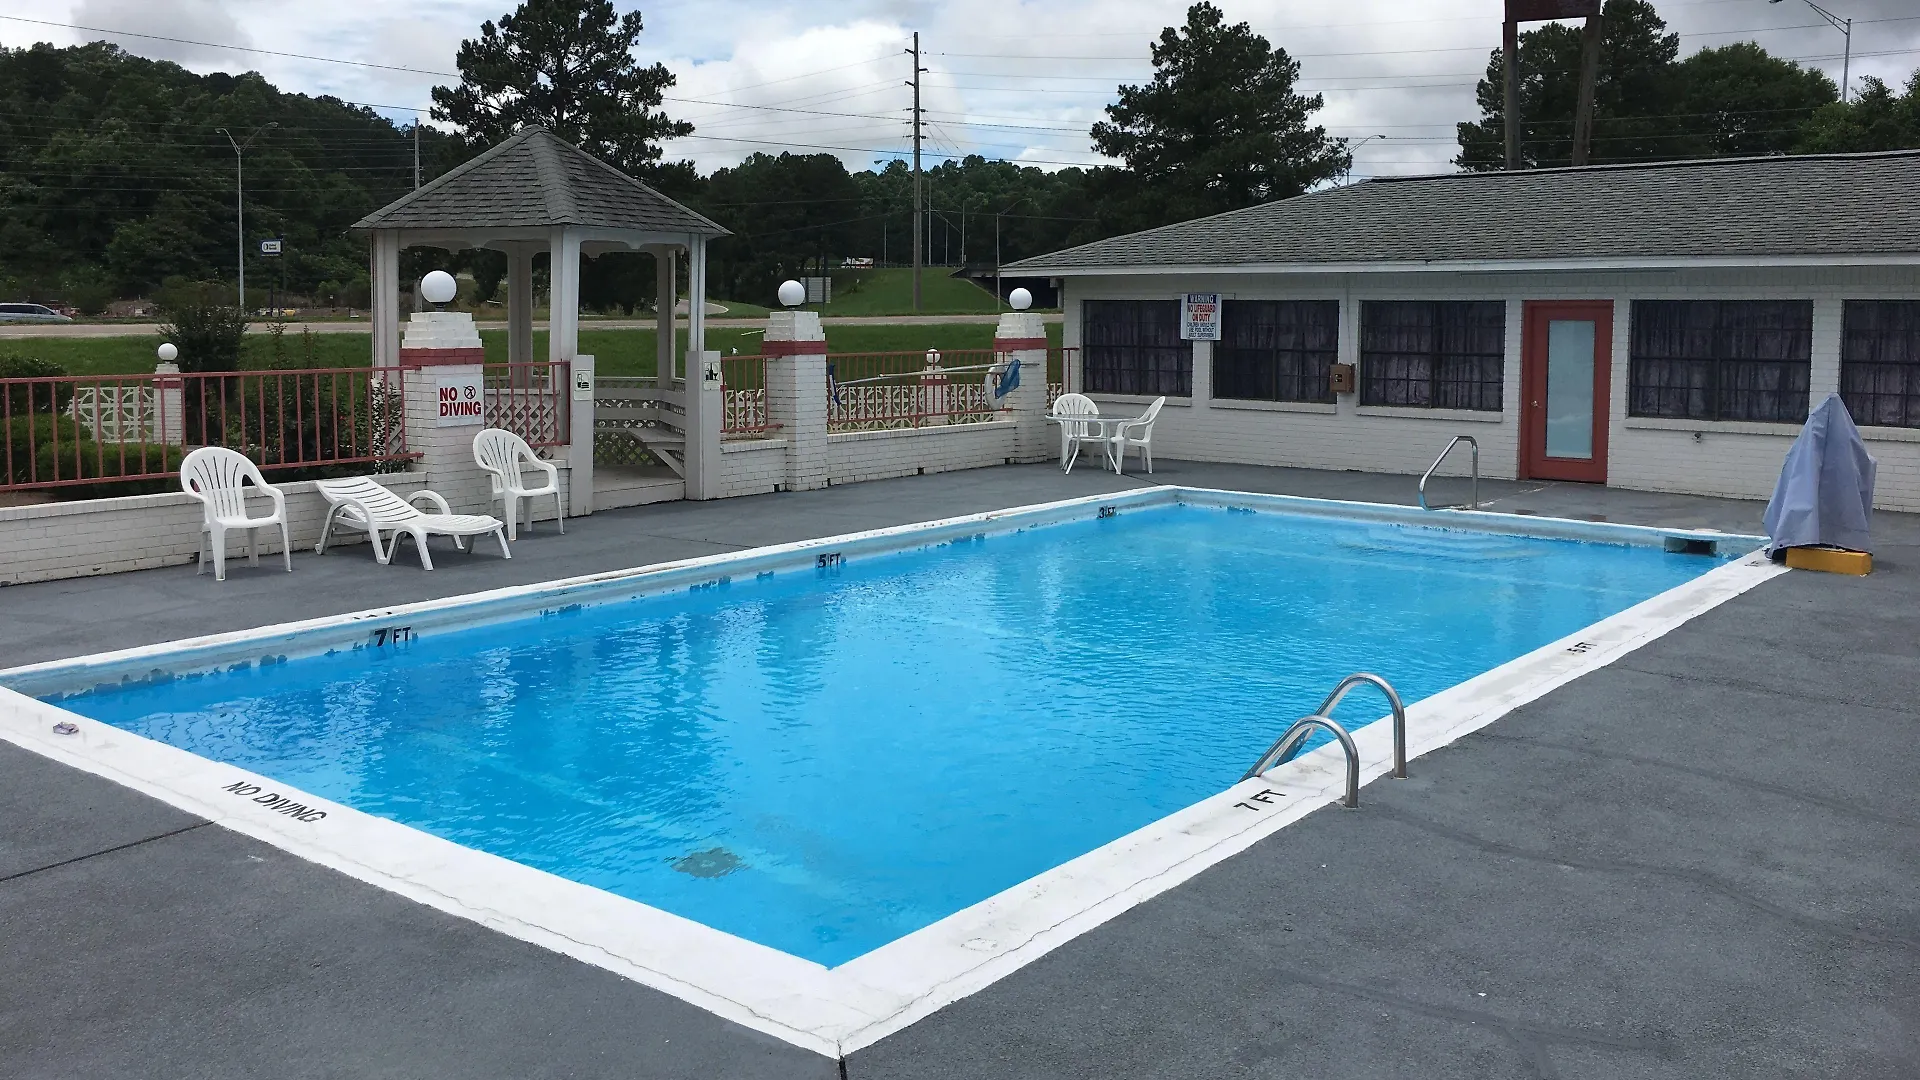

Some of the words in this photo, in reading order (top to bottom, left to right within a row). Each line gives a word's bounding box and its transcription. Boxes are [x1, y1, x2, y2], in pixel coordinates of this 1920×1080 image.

[1190, 294, 1214, 303] WARNING
[1188, 304, 1193, 312] NO
[1194, 304, 1216, 313] LIFEGUARD
[1192, 313, 1198, 321] ON
[1199, 313, 1211, 321] DUTY
[439, 387, 458, 401] NO
[439, 401, 482, 417] DIVING
[1099, 506, 1104, 518] 3
[818, 553, 827, 568] 5
[829, 552, 841, 567] FT
[374, 628, 388, 647] 7
[392, 626, 412, 644] FT
[221, 781, 261, 796] NO
[252, 792, 327, 822] DIVING
[1233, 802, 1260, 811] 7
[1250, 789, 1286, 804] FT
